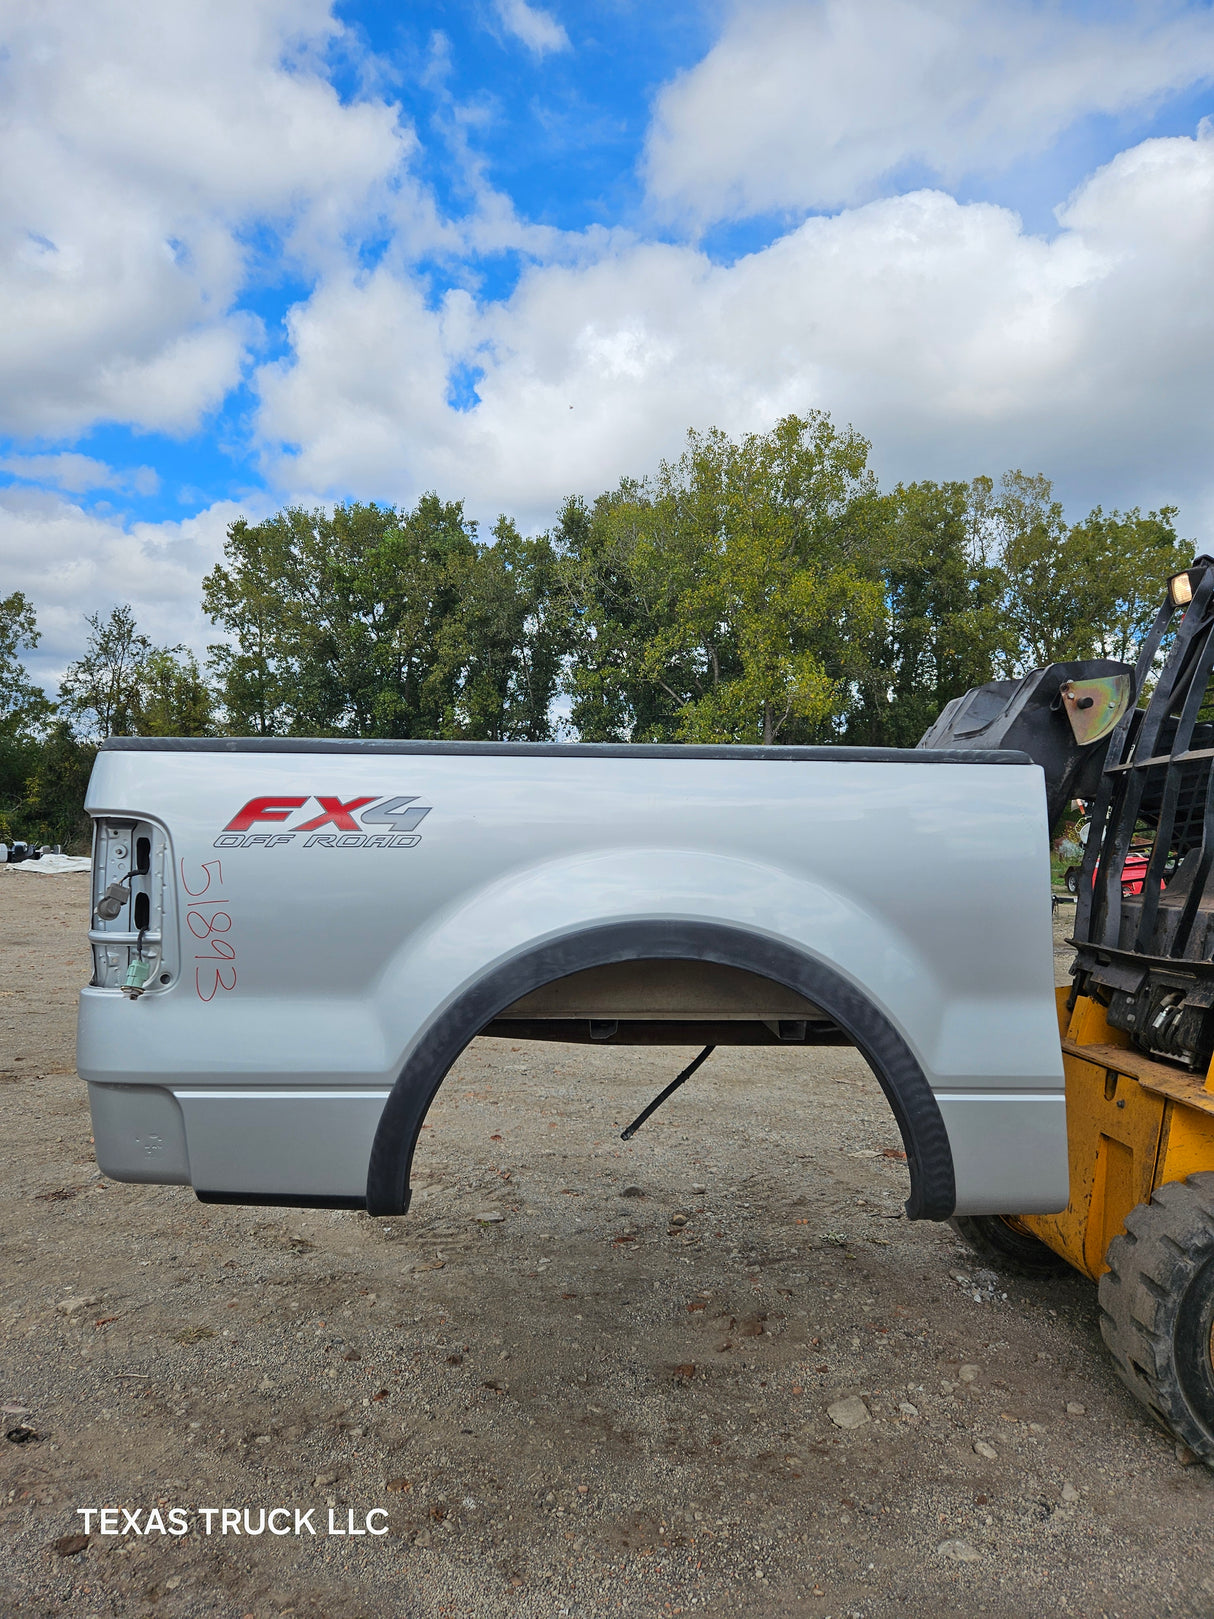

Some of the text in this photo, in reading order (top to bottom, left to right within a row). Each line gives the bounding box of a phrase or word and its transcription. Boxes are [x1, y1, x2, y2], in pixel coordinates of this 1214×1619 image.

[222, 795, 433, 832] FX4
[212, 833, 422, 849] OFF ROAD
[180, 857, 237, 1002] 51893
